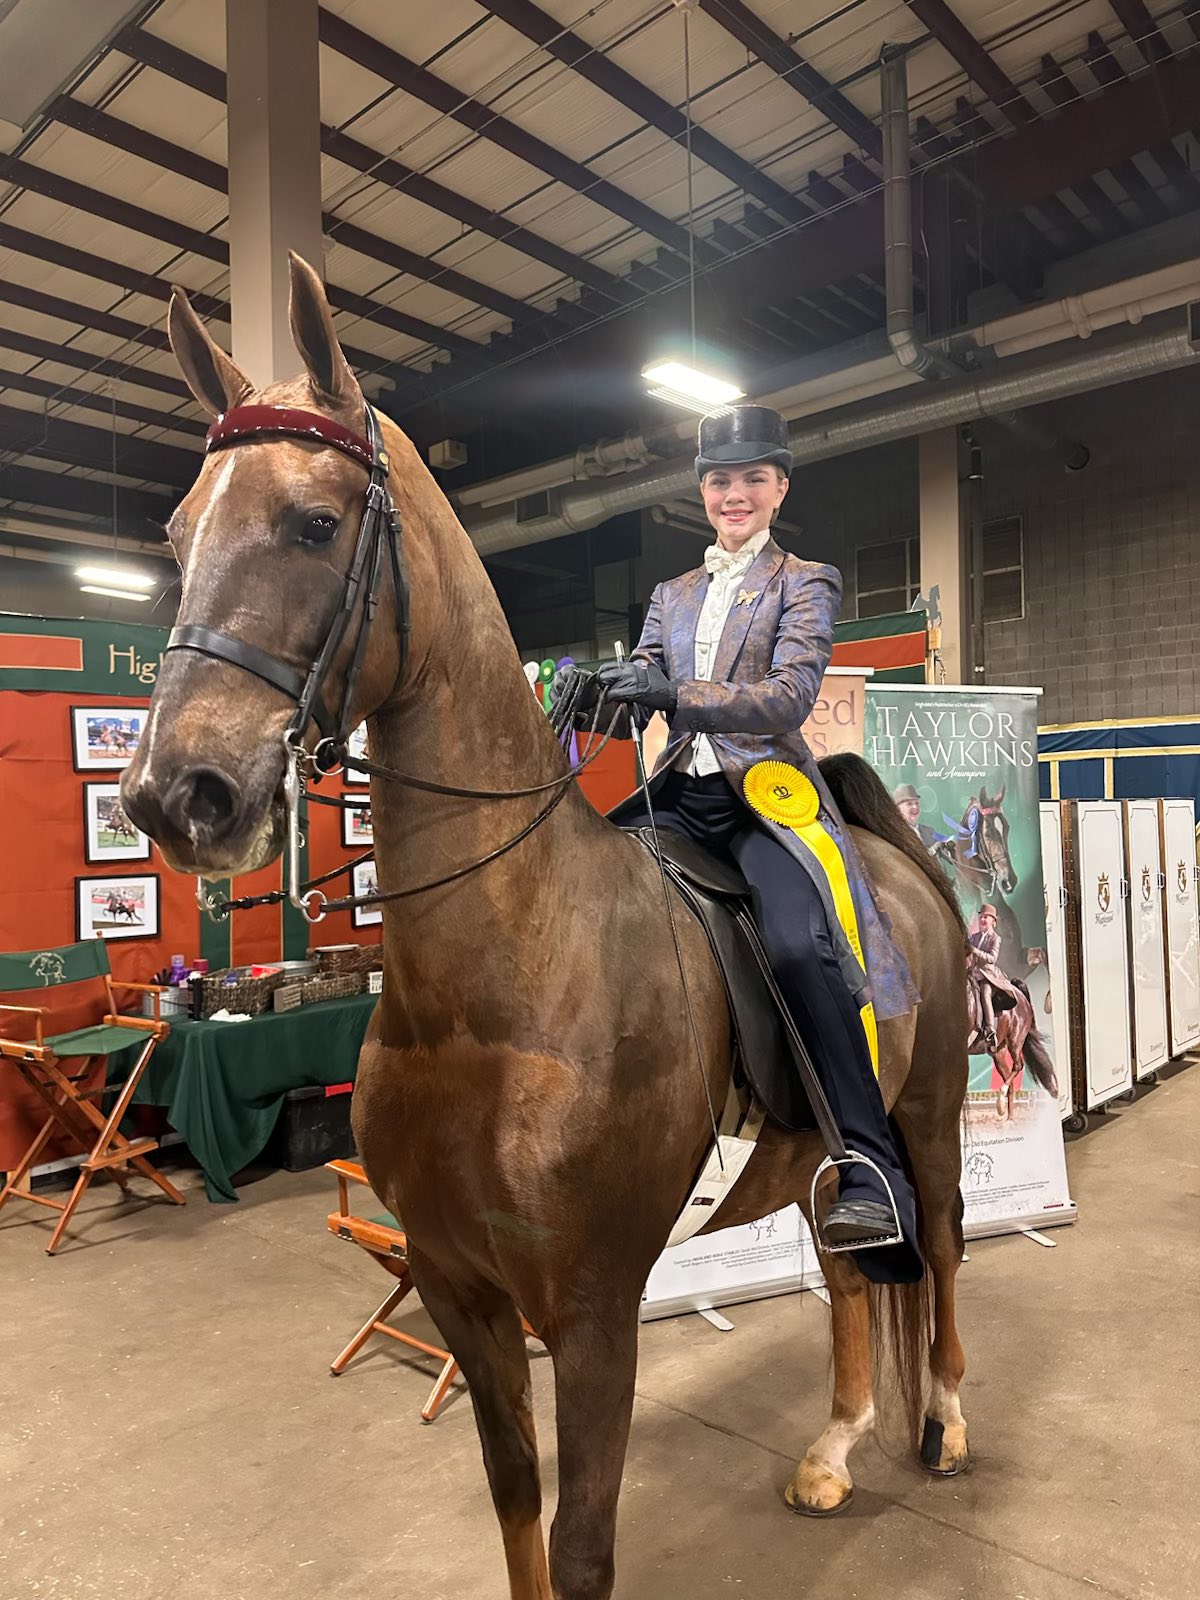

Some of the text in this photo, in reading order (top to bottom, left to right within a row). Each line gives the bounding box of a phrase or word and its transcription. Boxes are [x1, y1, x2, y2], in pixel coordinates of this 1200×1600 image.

[875, 706, 1018, 739] TAYLOR
[871, 735, 1034, 767] HAWKINS
[926, 767, 943, 778] and
[981, 1138, 1006, 1147] Equitation
[1006, 1136, 1024, 1144] Division
